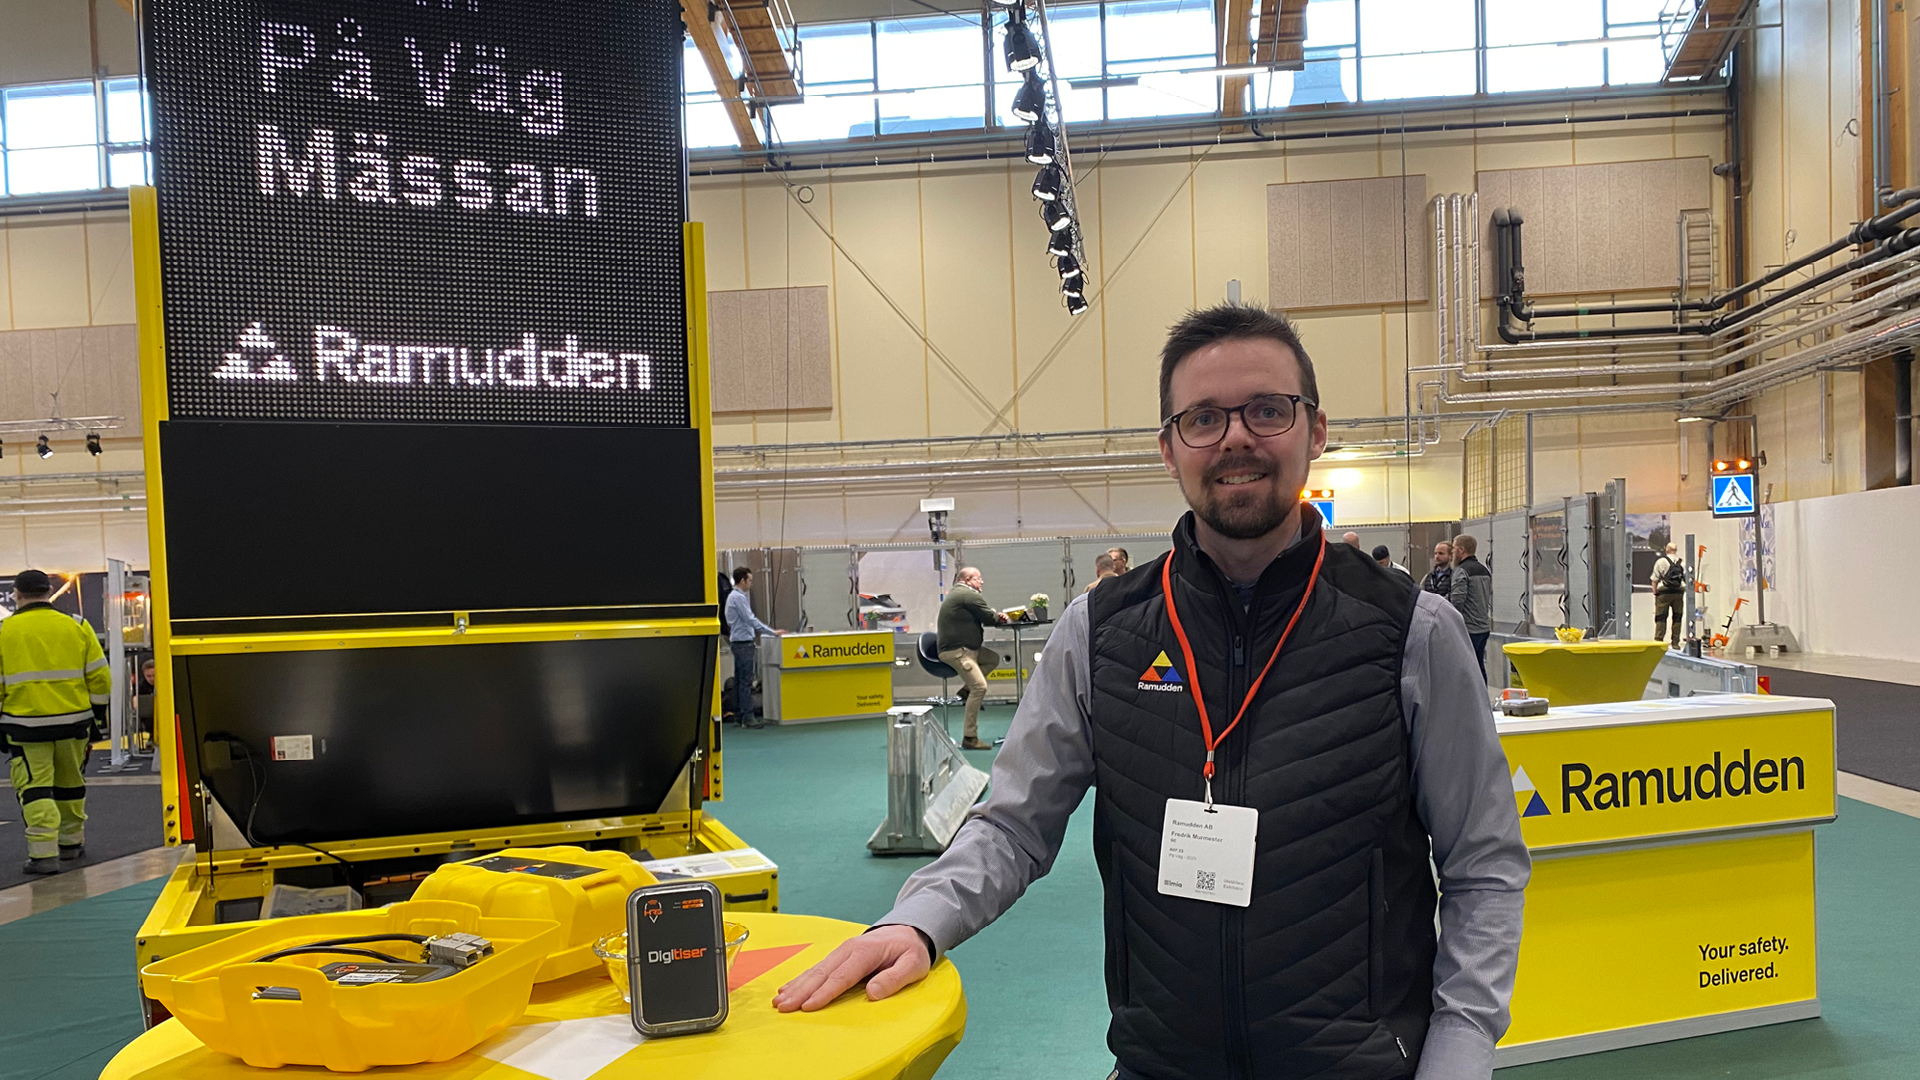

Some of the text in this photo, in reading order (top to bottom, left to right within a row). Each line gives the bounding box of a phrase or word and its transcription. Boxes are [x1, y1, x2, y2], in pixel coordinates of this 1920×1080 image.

[260, 16, 564, 136] På Väg
[257, 124, 599, 217] Mässan
[314, 324, 653, 390] Ramudden
[812, 642, 886, 658] Ramudden
[1138, 682, 1183, 692] Ramudden
[1561, 749, 1805, 814] Ramudden
[1172, 820, 1203, 829] Ramudden
[648, 947, 707, 964] Digitiser
[1699, 936, 1789, 961] Your safety.
[1699, 962, 1778, 988] Delivered.
